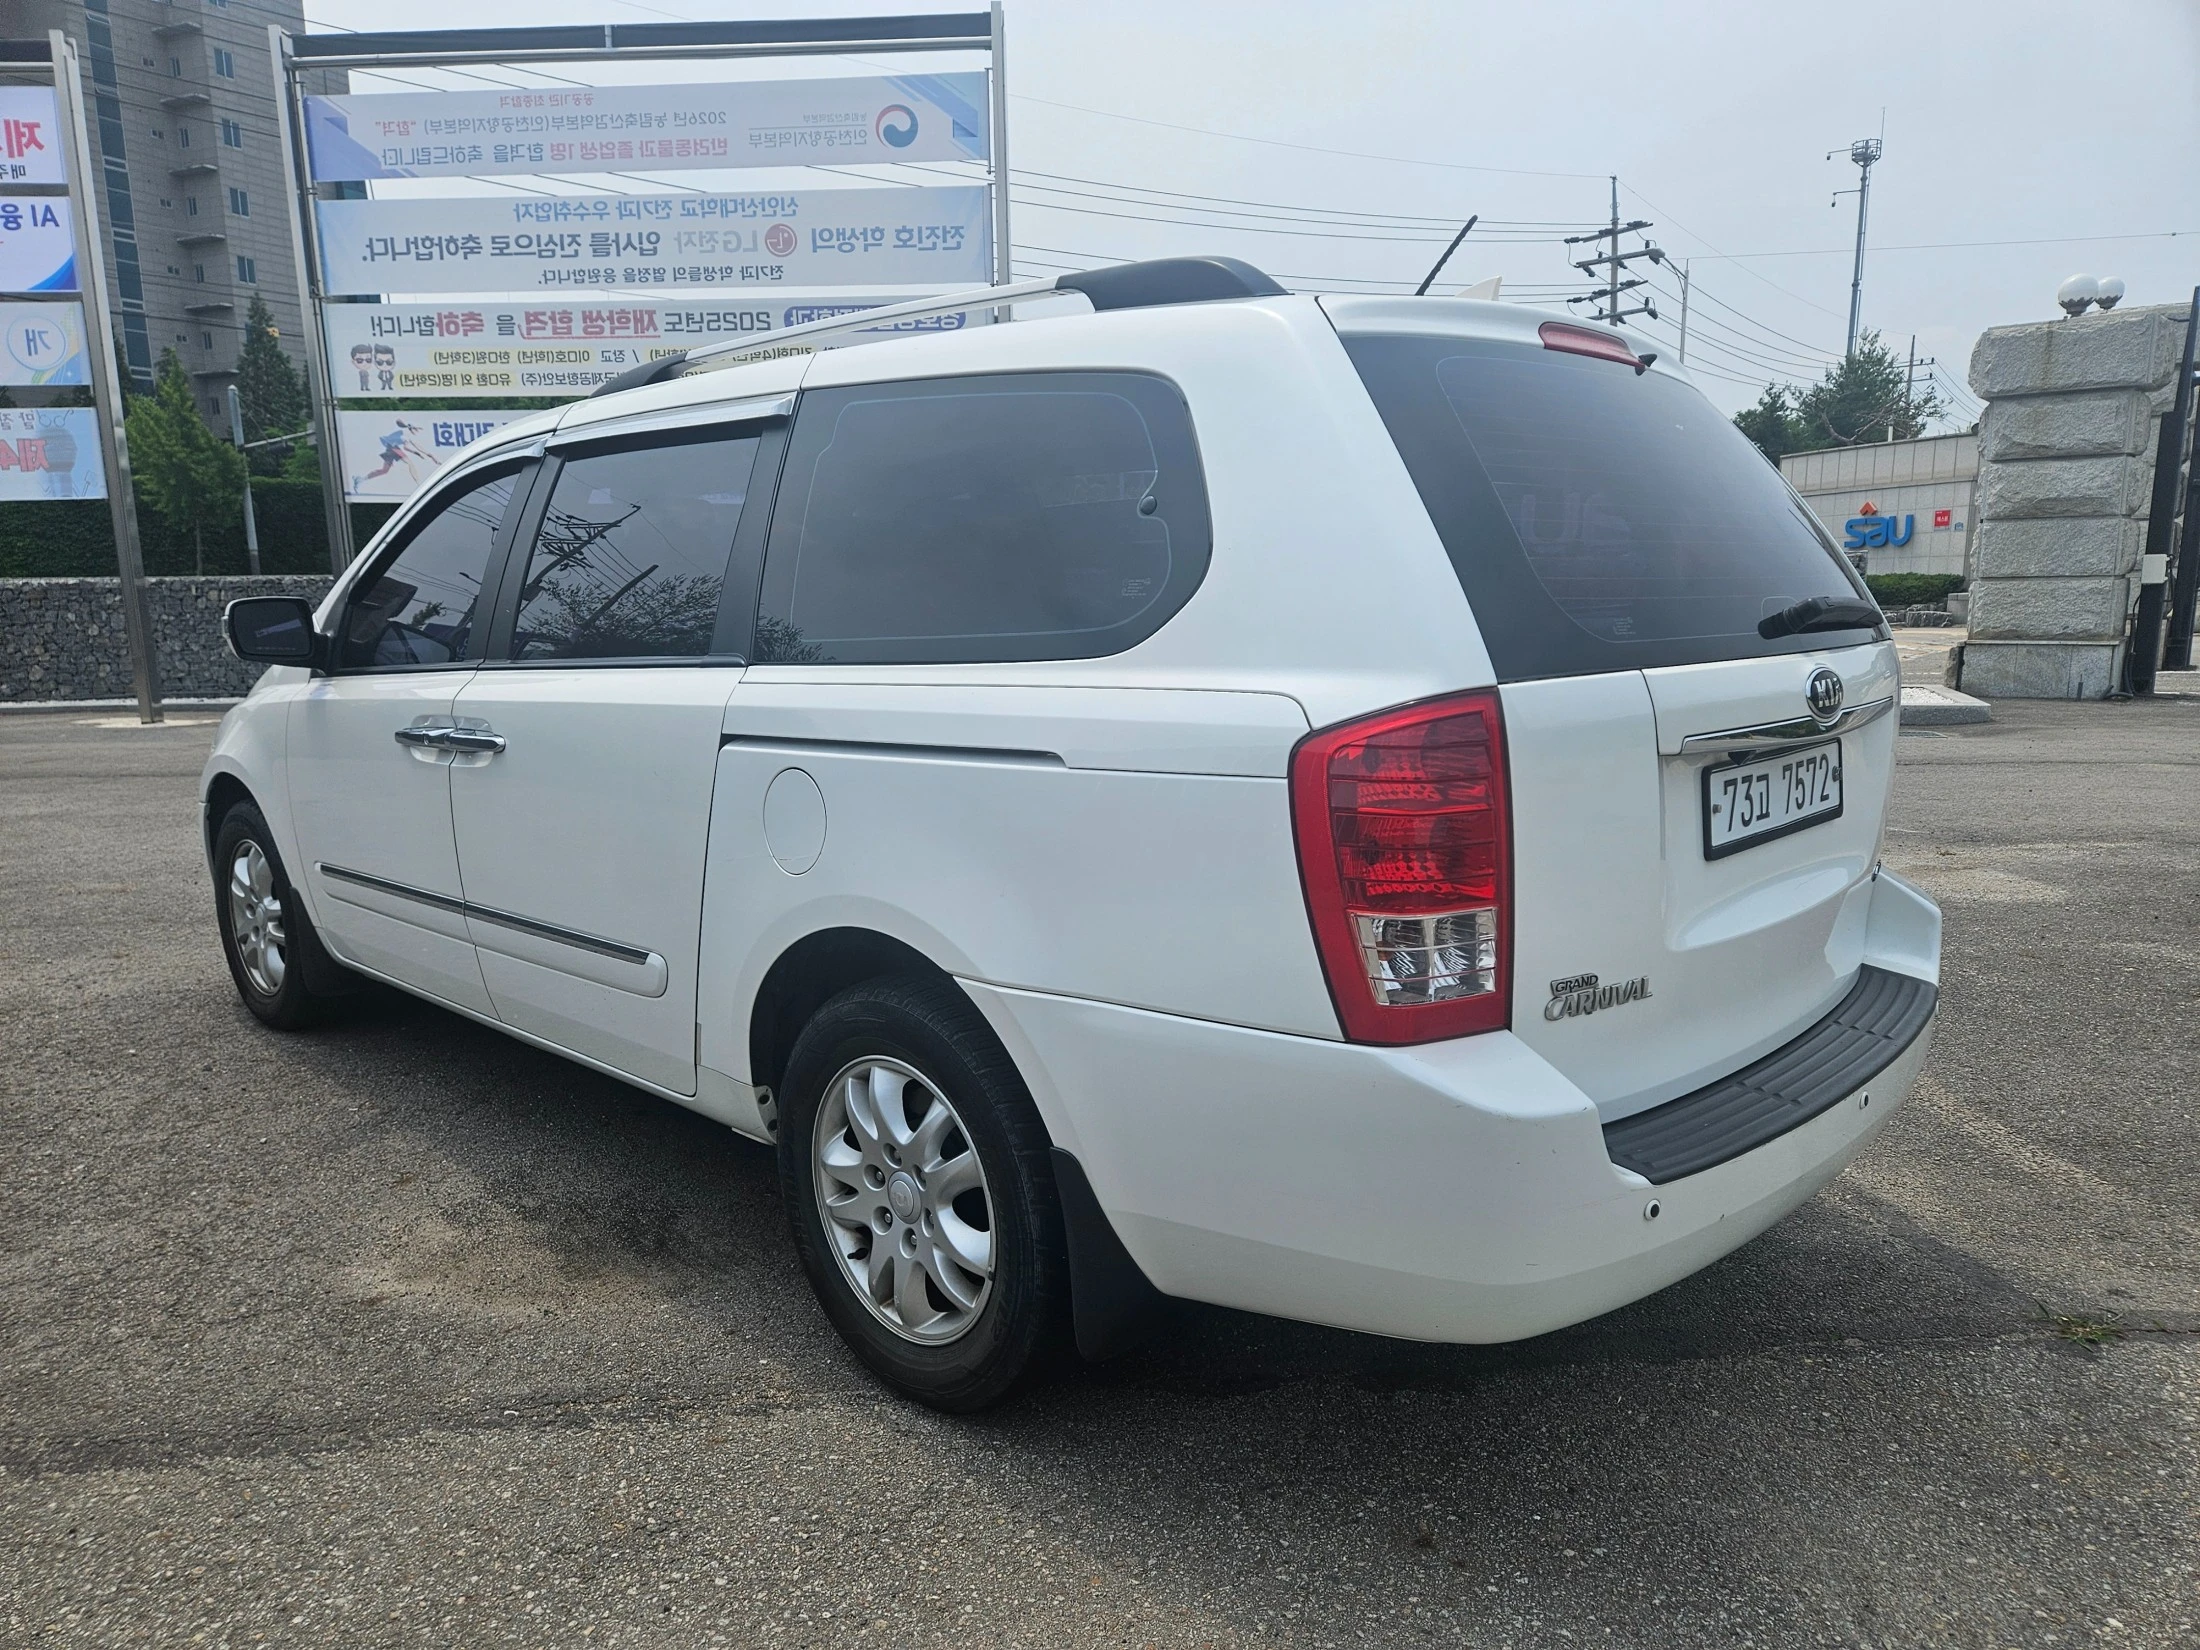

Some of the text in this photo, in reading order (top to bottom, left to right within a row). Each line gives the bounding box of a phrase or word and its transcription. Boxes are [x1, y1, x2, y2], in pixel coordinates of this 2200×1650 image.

[1814, 677, 1842, 708] KIA
[1723, 753, 1830, 833] 73고 7572
[1544, 975, 1653, 1021] CARNIVAL
[1555, 974, 1599, 993] GRAND
